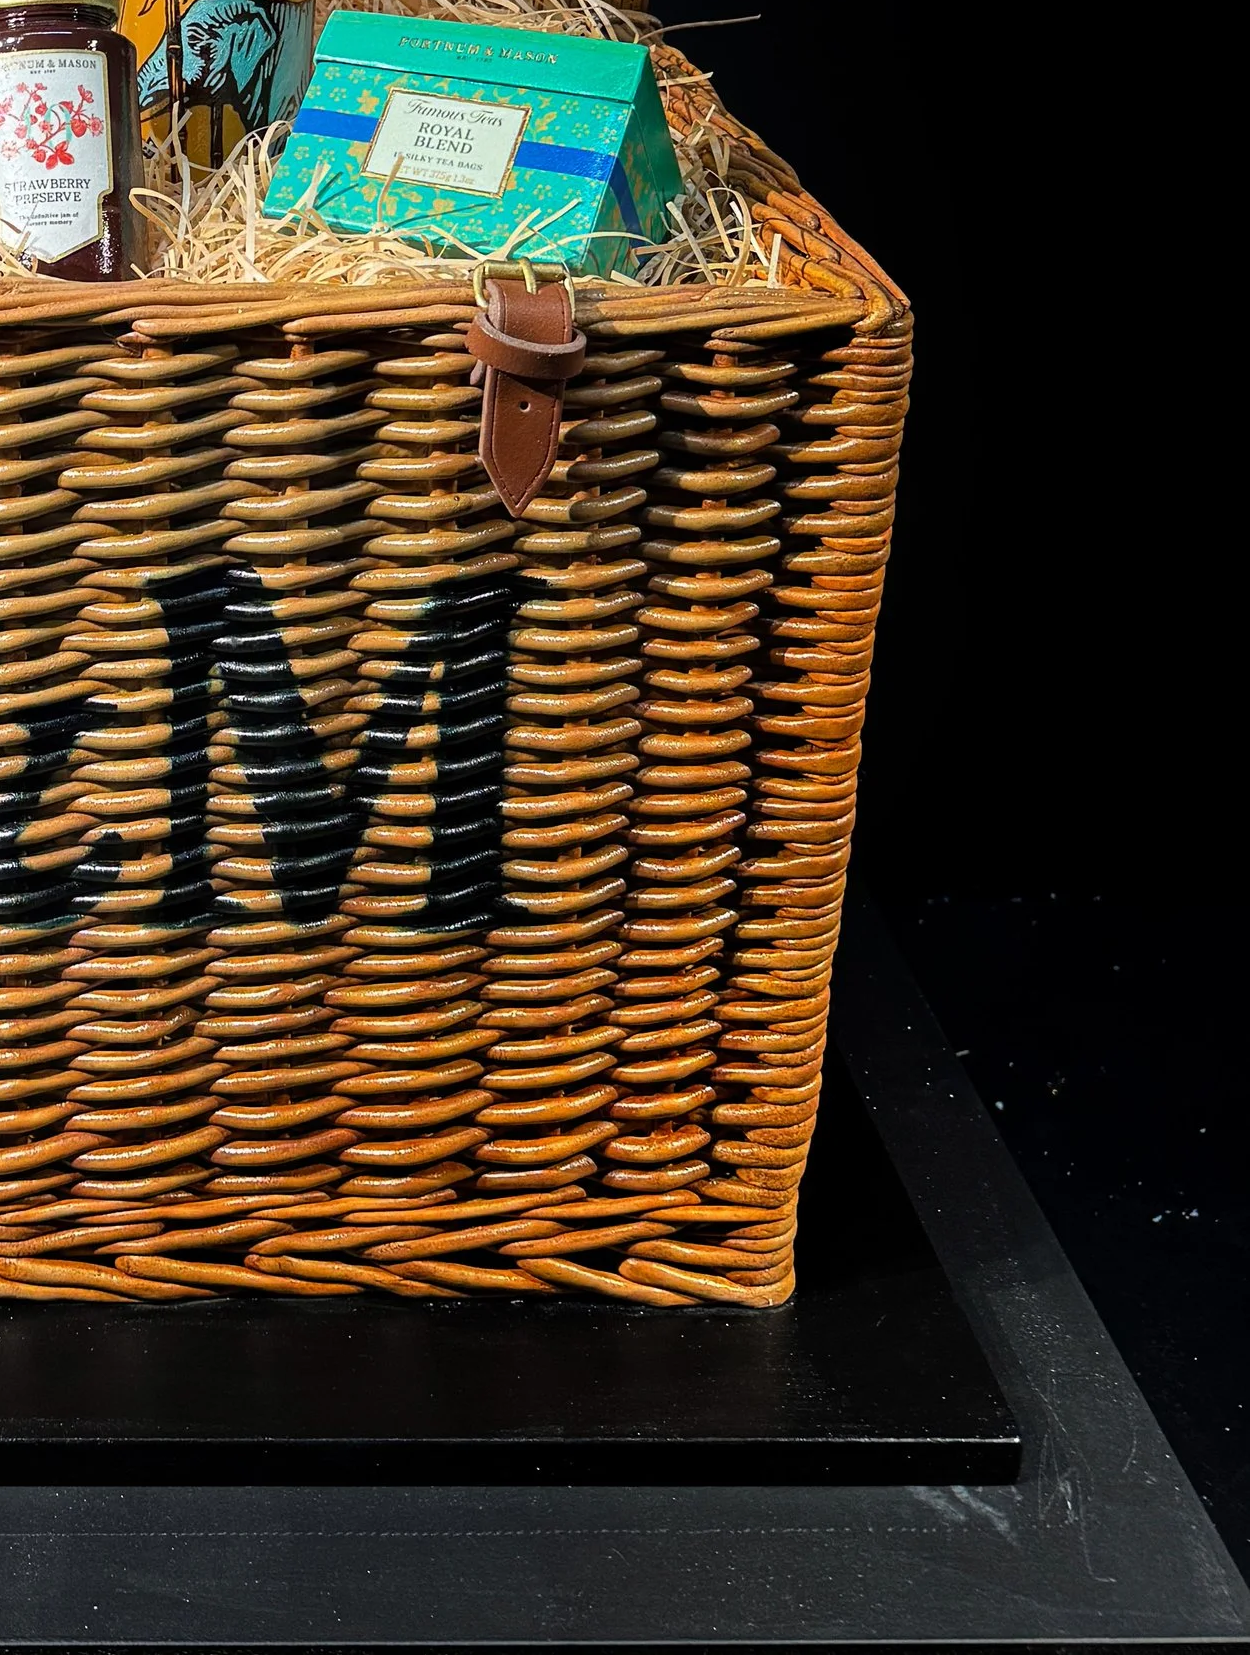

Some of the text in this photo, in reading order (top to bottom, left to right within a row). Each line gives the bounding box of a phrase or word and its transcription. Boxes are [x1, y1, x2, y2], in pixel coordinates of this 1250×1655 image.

[399, 36, 559, 64] FORTNUM & MASON
[46, 59, 56, 69] &
[58, 59, 97, 69] MASON
[404, 98, 503, 127] Famous Teas
[418, 121, 475, 141] ROYAL
[414, 135, 473, 154] BLEND
[406, 153, 434, 163] SILKY
[436, 157, 455, 166] TEA
[457, 161, 483, 171] BAGS
[4, 178, 91, 194] STRAWBERRY
[14, 191, 82, 205] PRESERVE
